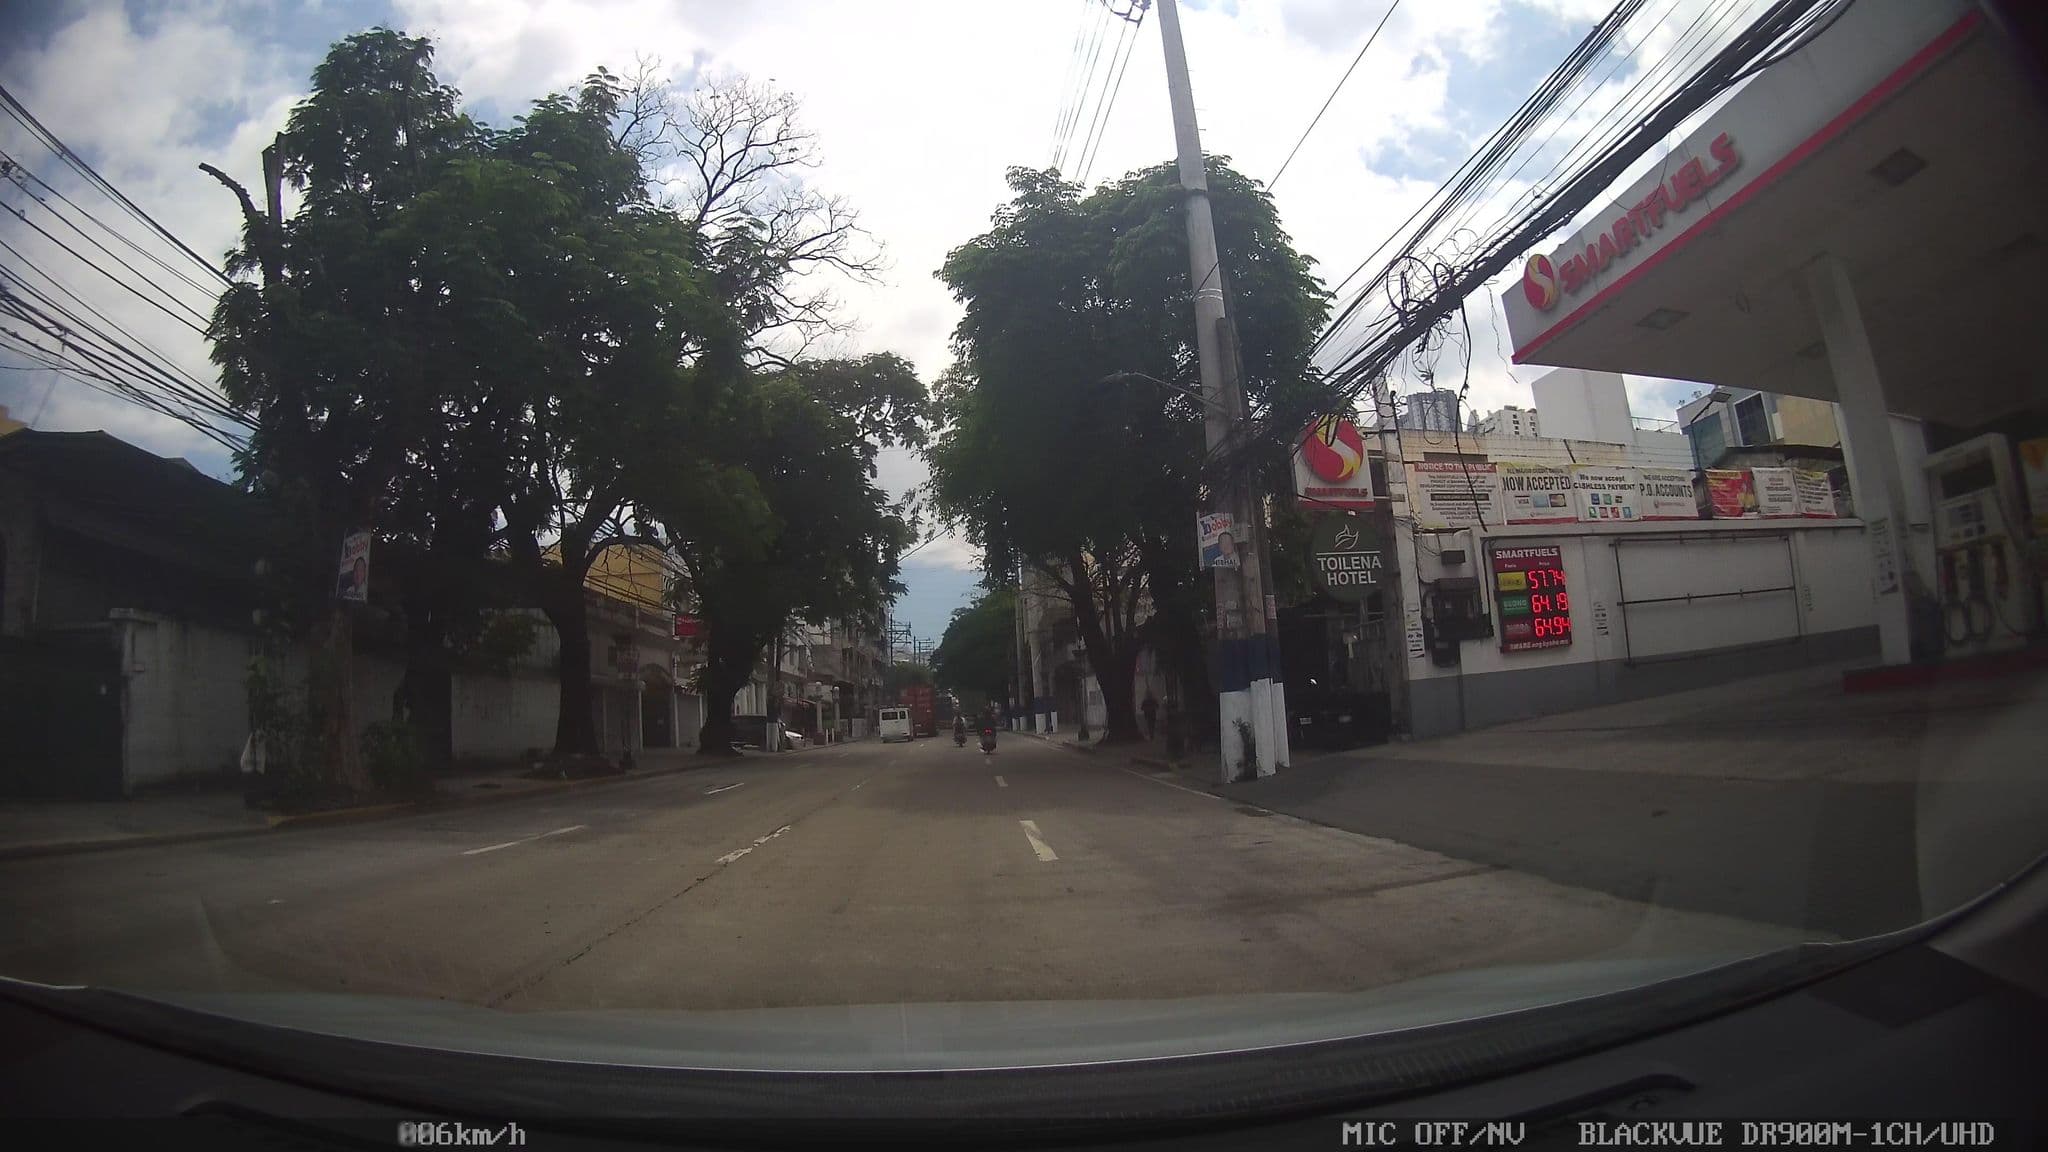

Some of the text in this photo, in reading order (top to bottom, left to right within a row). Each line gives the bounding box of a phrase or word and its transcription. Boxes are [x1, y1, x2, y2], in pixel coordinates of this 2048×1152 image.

[1558, 132, 1738, 294] SMARTFUELS
[1418, 463, 1443, 471] NOTICE
[1444, 463, 1453, 471] TO
[1502, 475, 1524, 491] NOW
[1526, 475, 1571, 491] ACCEPTED
[1578, 473, 1589, 481] We
[1605, 475, 1625, 483] accept
[1573, 482, 1636, 491] CASHLESS PAYMENT
[1655, 483, 1693, 498] ACCOUNTS
[1495, 548, 1558, 559] SMARTFUELS
[1317, 556, 1382, 571] TOILENA
[1327, 571, 1377, 586] HOTEL
[1531, 592, 1569, 613] 64.19
[1534, 616, 1572, 637] 64.94
